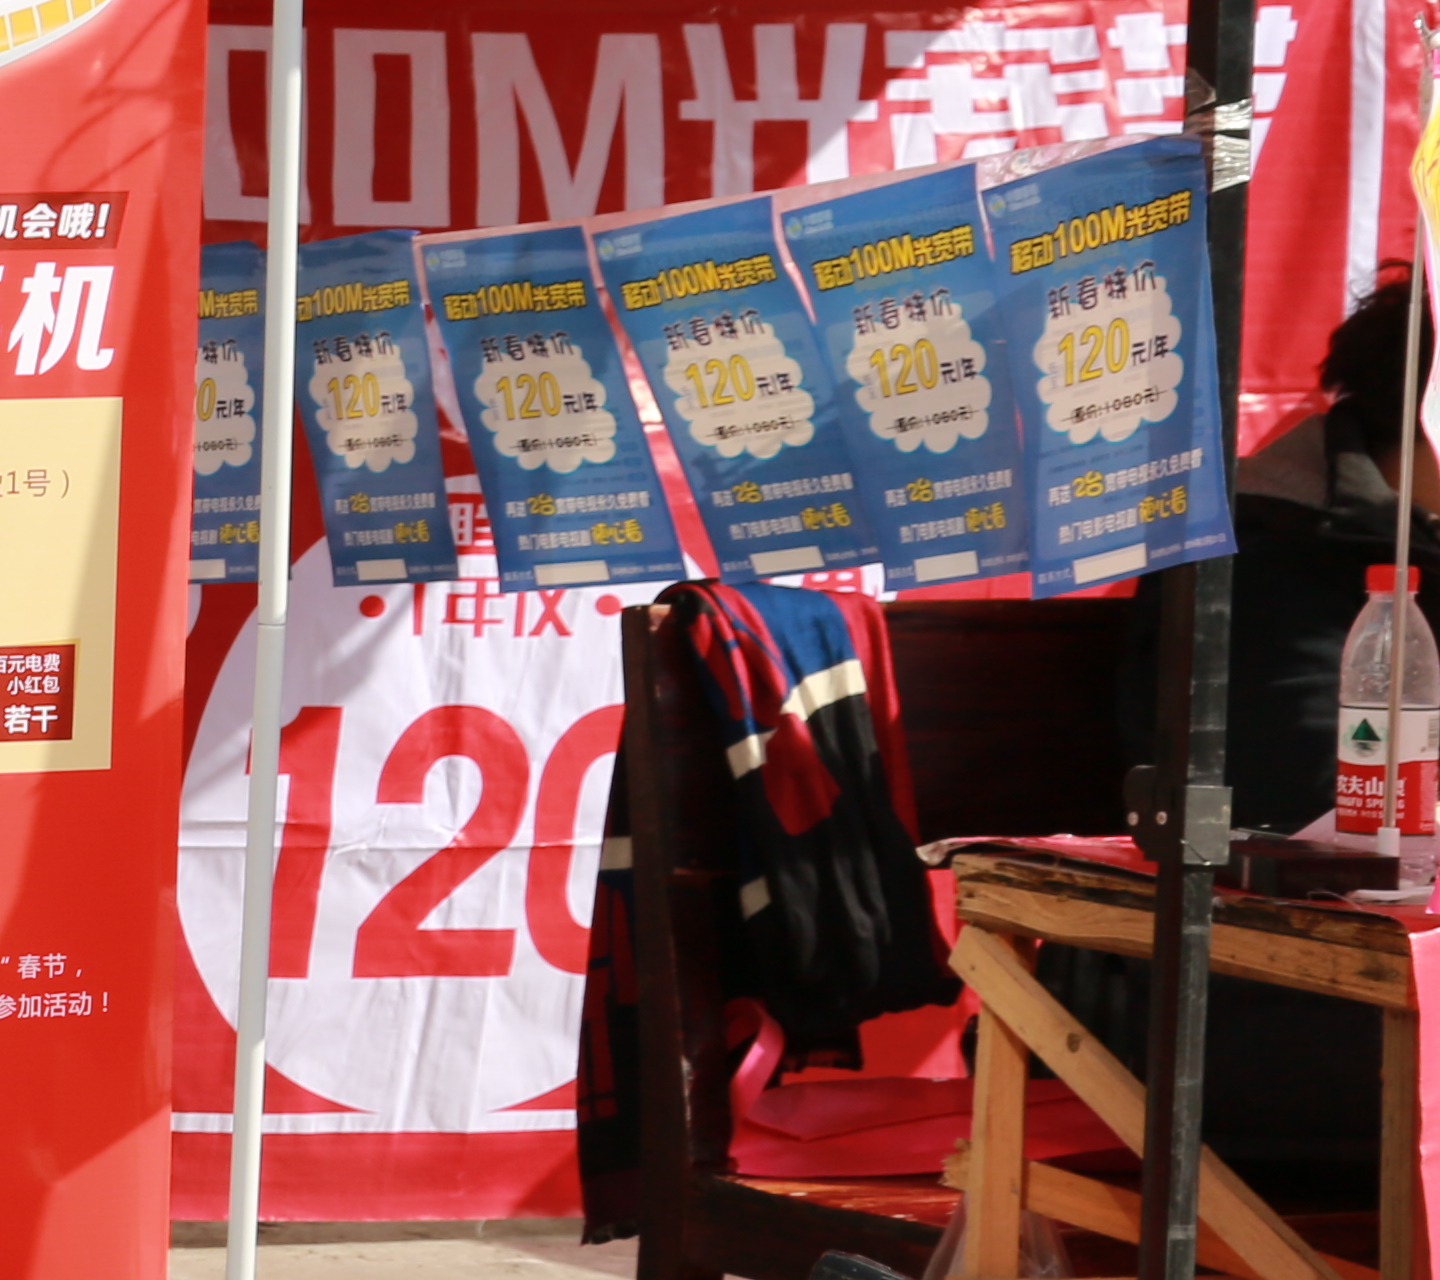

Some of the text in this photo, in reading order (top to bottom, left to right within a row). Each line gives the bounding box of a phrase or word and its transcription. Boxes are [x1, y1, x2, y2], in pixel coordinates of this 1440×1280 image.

[1010, 191, 1192, 275] 移动100M光宽带
[1048, 261, 1156, 319] 新春特价
[6, 675, 60, 695] 小红包
[3, 704, 58, 734] 若干
